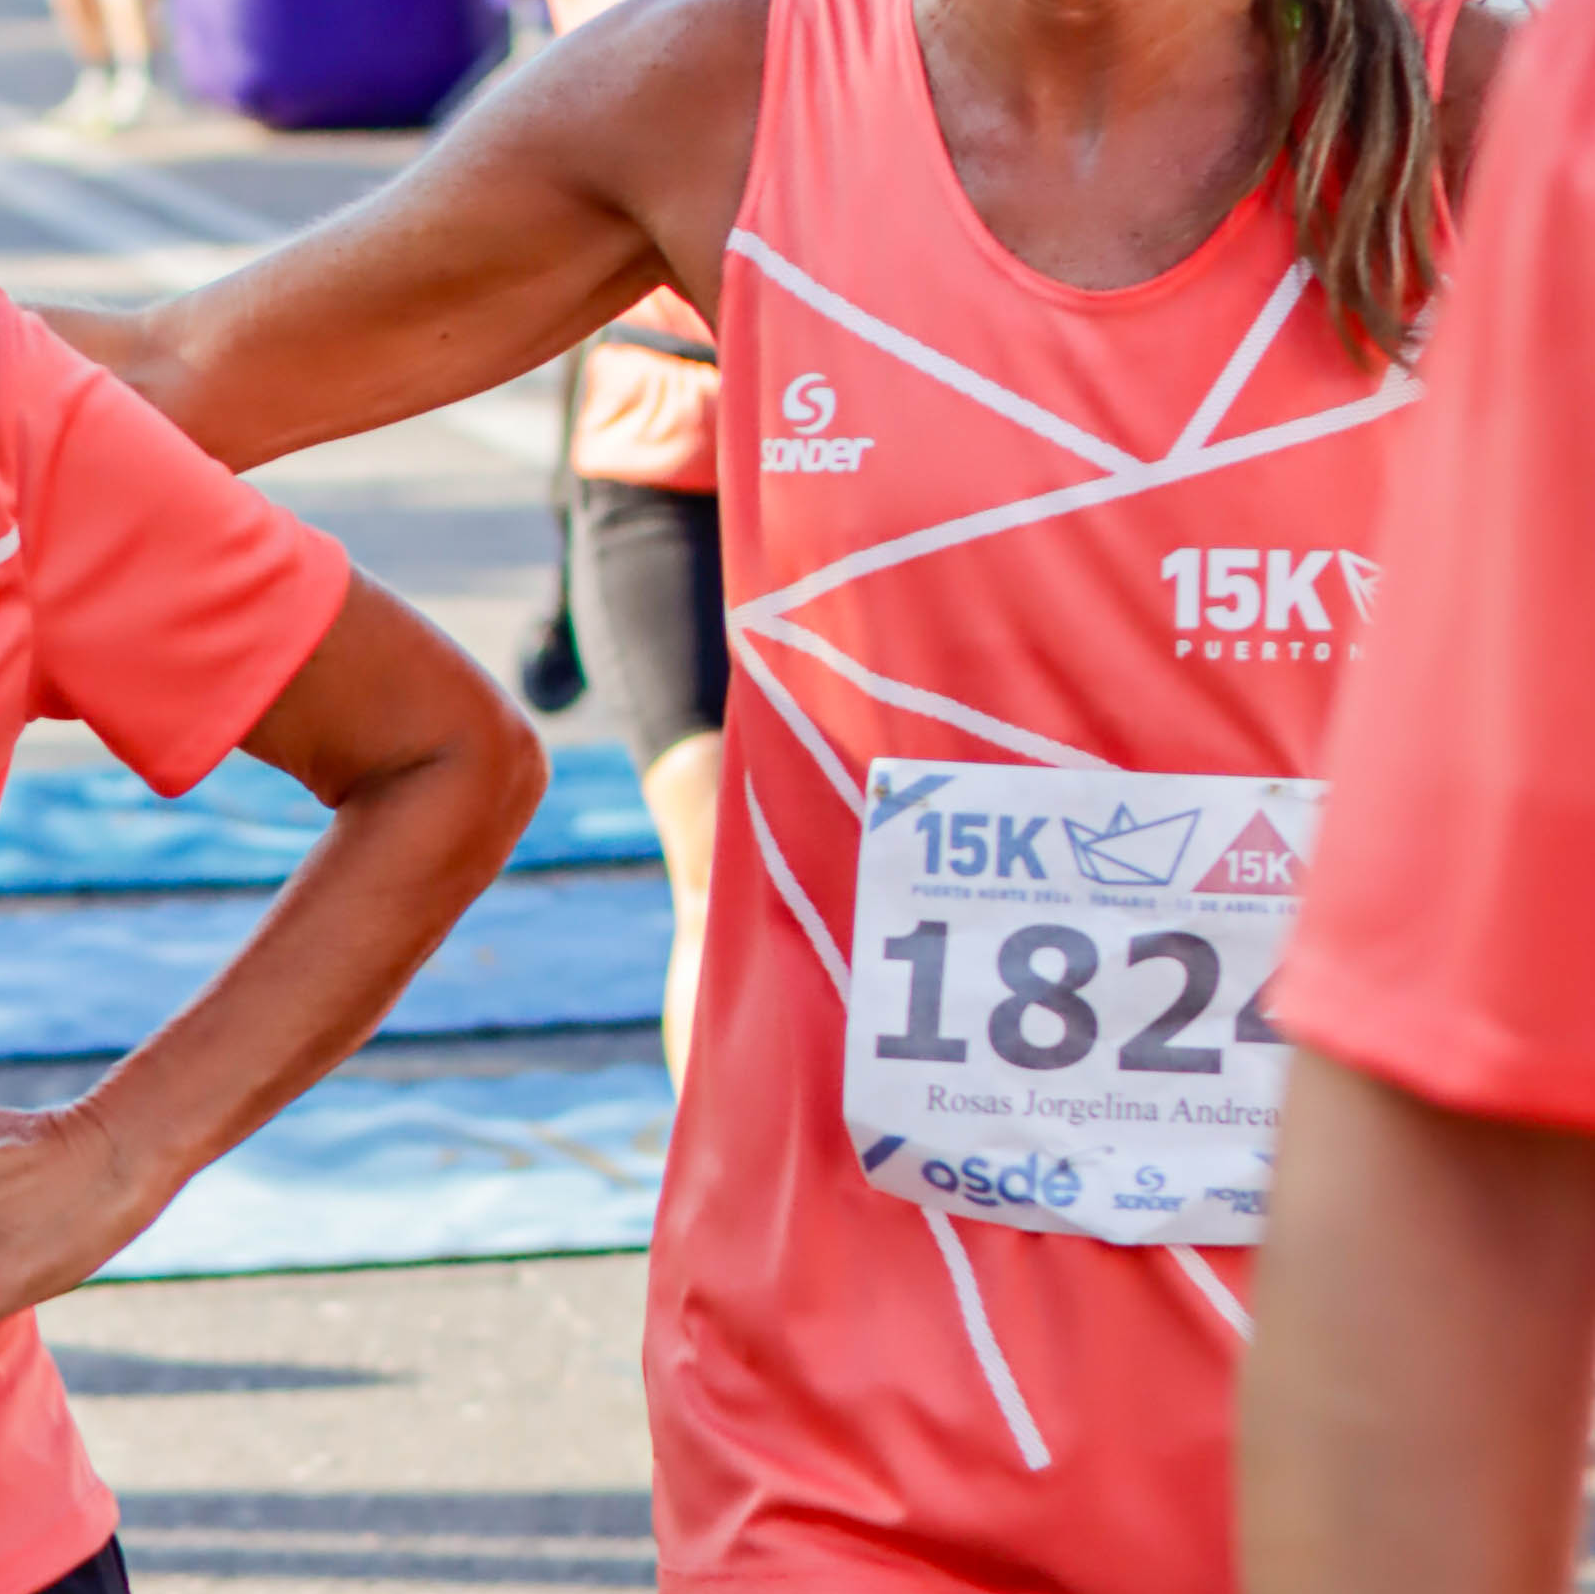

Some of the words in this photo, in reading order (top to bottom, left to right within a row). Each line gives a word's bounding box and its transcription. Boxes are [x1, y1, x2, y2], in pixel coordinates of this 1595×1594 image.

[1161, 547, 1334, 631] 15K
[1175, 639, 1331, 661] PUERTO
[916, 811, 1049, 880] 15K
[1225, 850, 1293, 885] 15K
[926, 1084, 1012, 1116] Rosas
[1022, 1090, 1158, 1126] Jorgelina
[1168, 1097, 1280, 1127] Andrea
[921, 1153, 1082, 1208] osde
